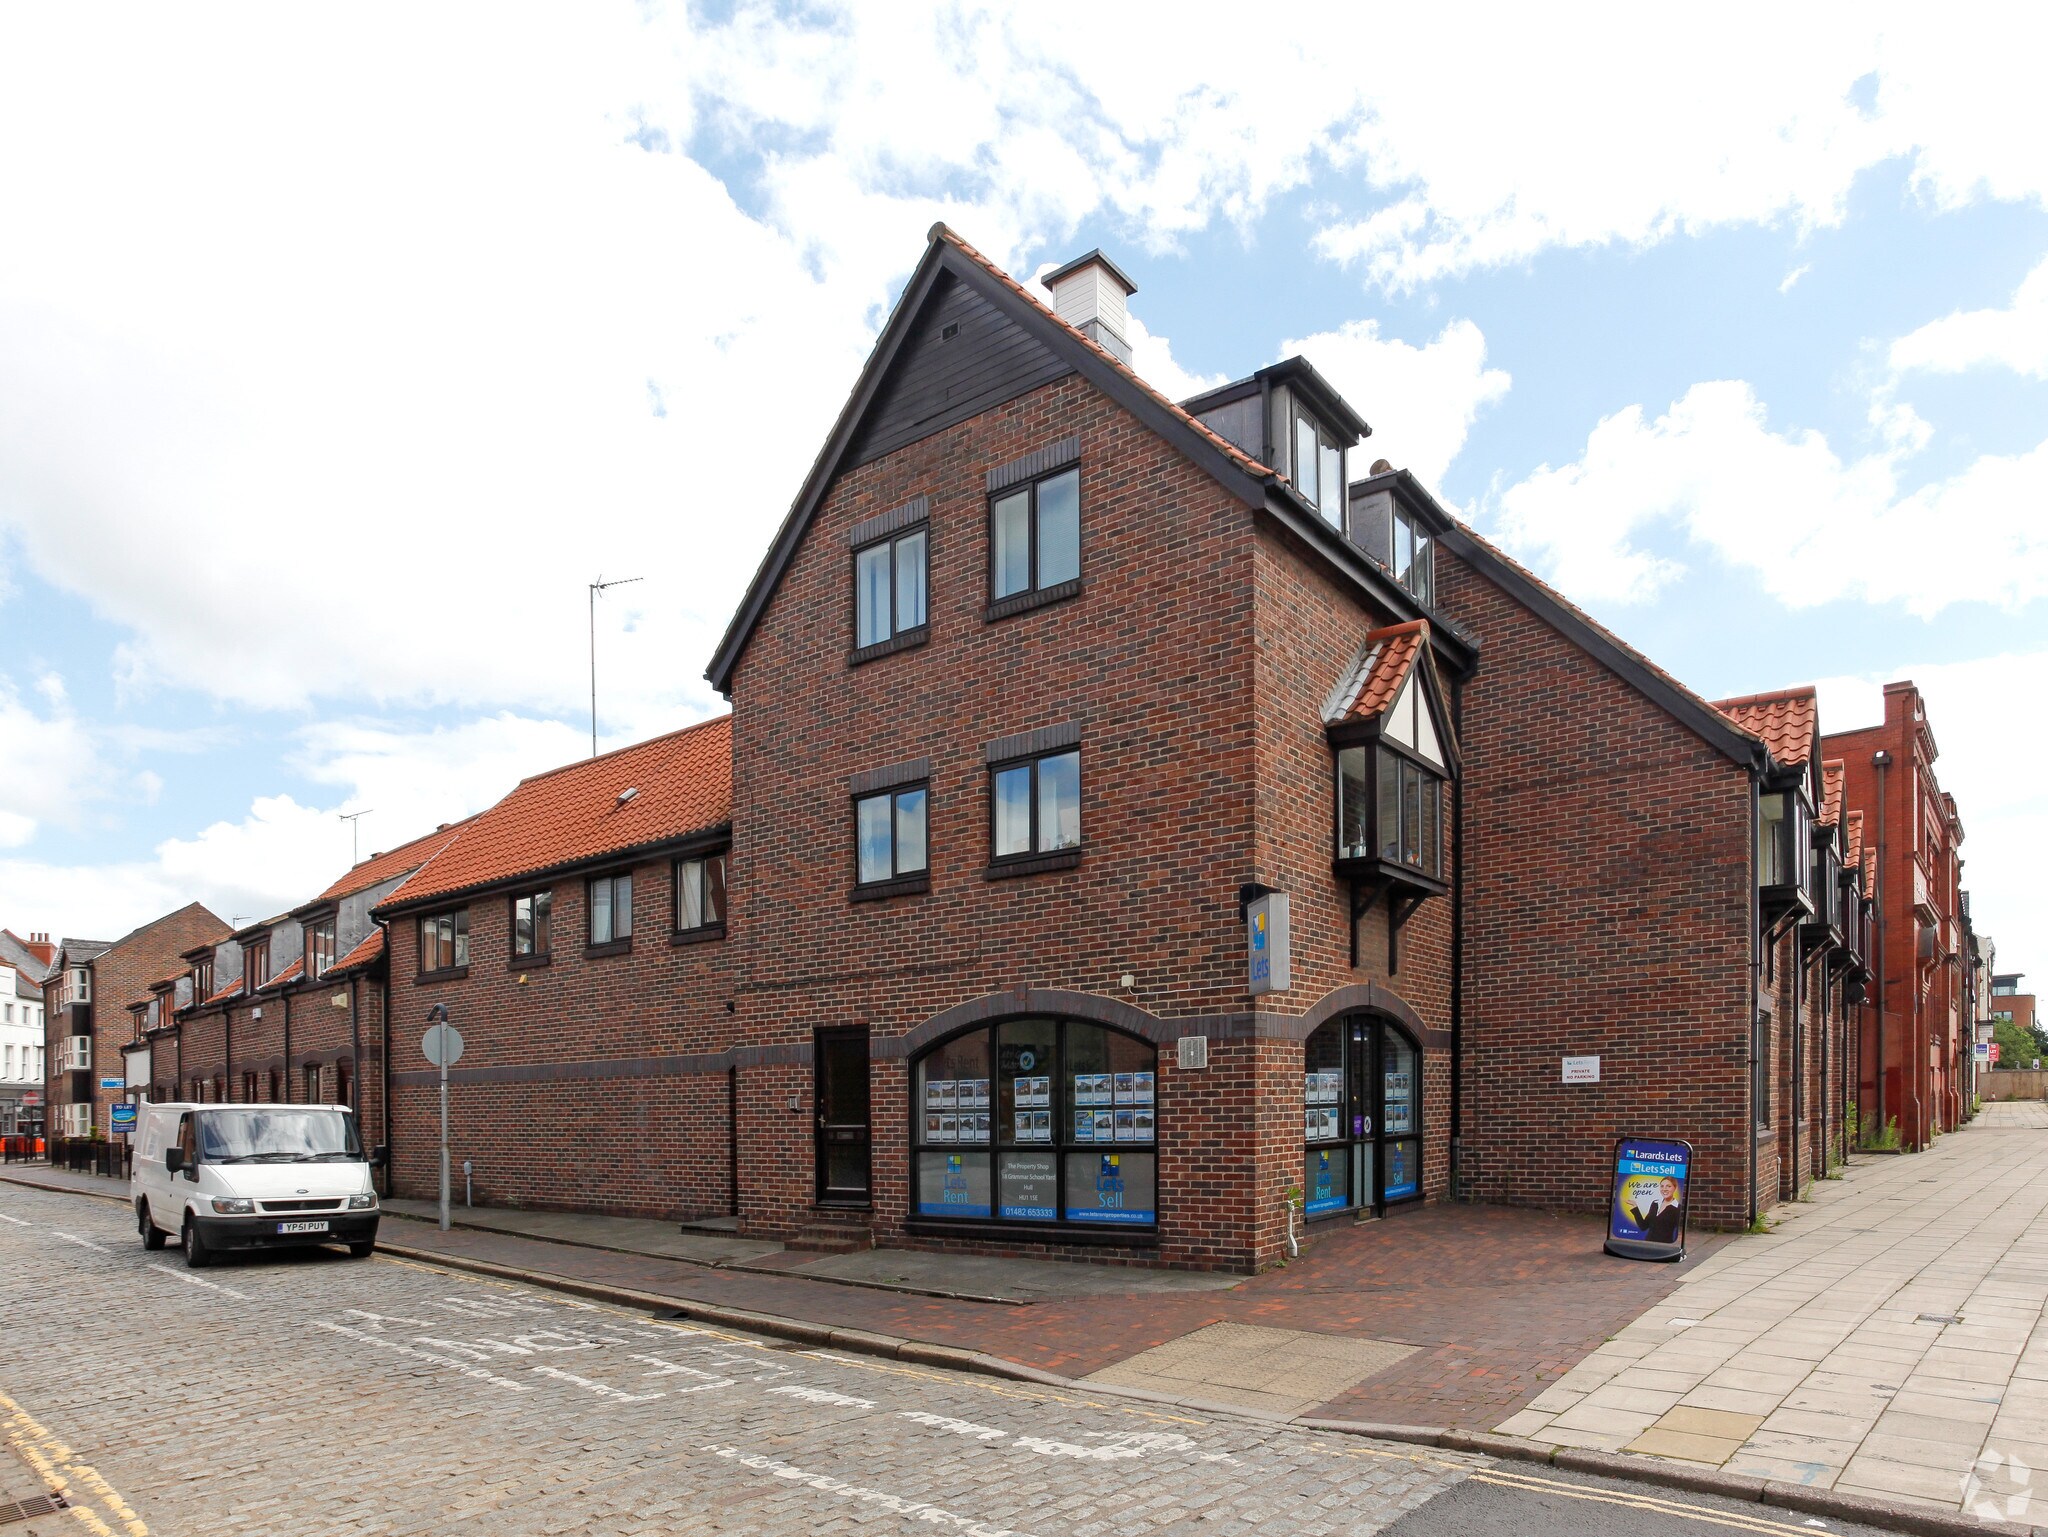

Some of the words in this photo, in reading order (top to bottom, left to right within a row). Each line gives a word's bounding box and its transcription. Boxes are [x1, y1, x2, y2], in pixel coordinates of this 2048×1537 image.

[1251, 957, 1269, 981] Lets
[1635, 1150, 1665, 1161] Larards
[1665, 1152, 1683, 1162] Lets
[1016, 1163, 1037, 1171] Property
[1036, 1163, 1050, 1171] Shop
[1641, 1164, 1659, 1174] Lets
[1659, 1165, 1676, 1175] Sell
[944, 1174, 968, 1189] Lets
[1096, 1174, 1125, 1192] Lets
[1393, 1171, 1404, 1185] Sell
[1628, 1181, 1643, 1189] We
[943, 1189, 969, 1204] Rent
[1316, 1185, 1332, 1200] Rent
[1632, 1189, 1654, 1199] open
[1098, 1191, 1123, 1208] Sell
[1005, 1207, 1026, 1216] 01482
[1027, 1208, 1053, 1217] 653333
[286, 1223, 307, 1231] YP51
[308, 1222, 326, 1230] PUY
